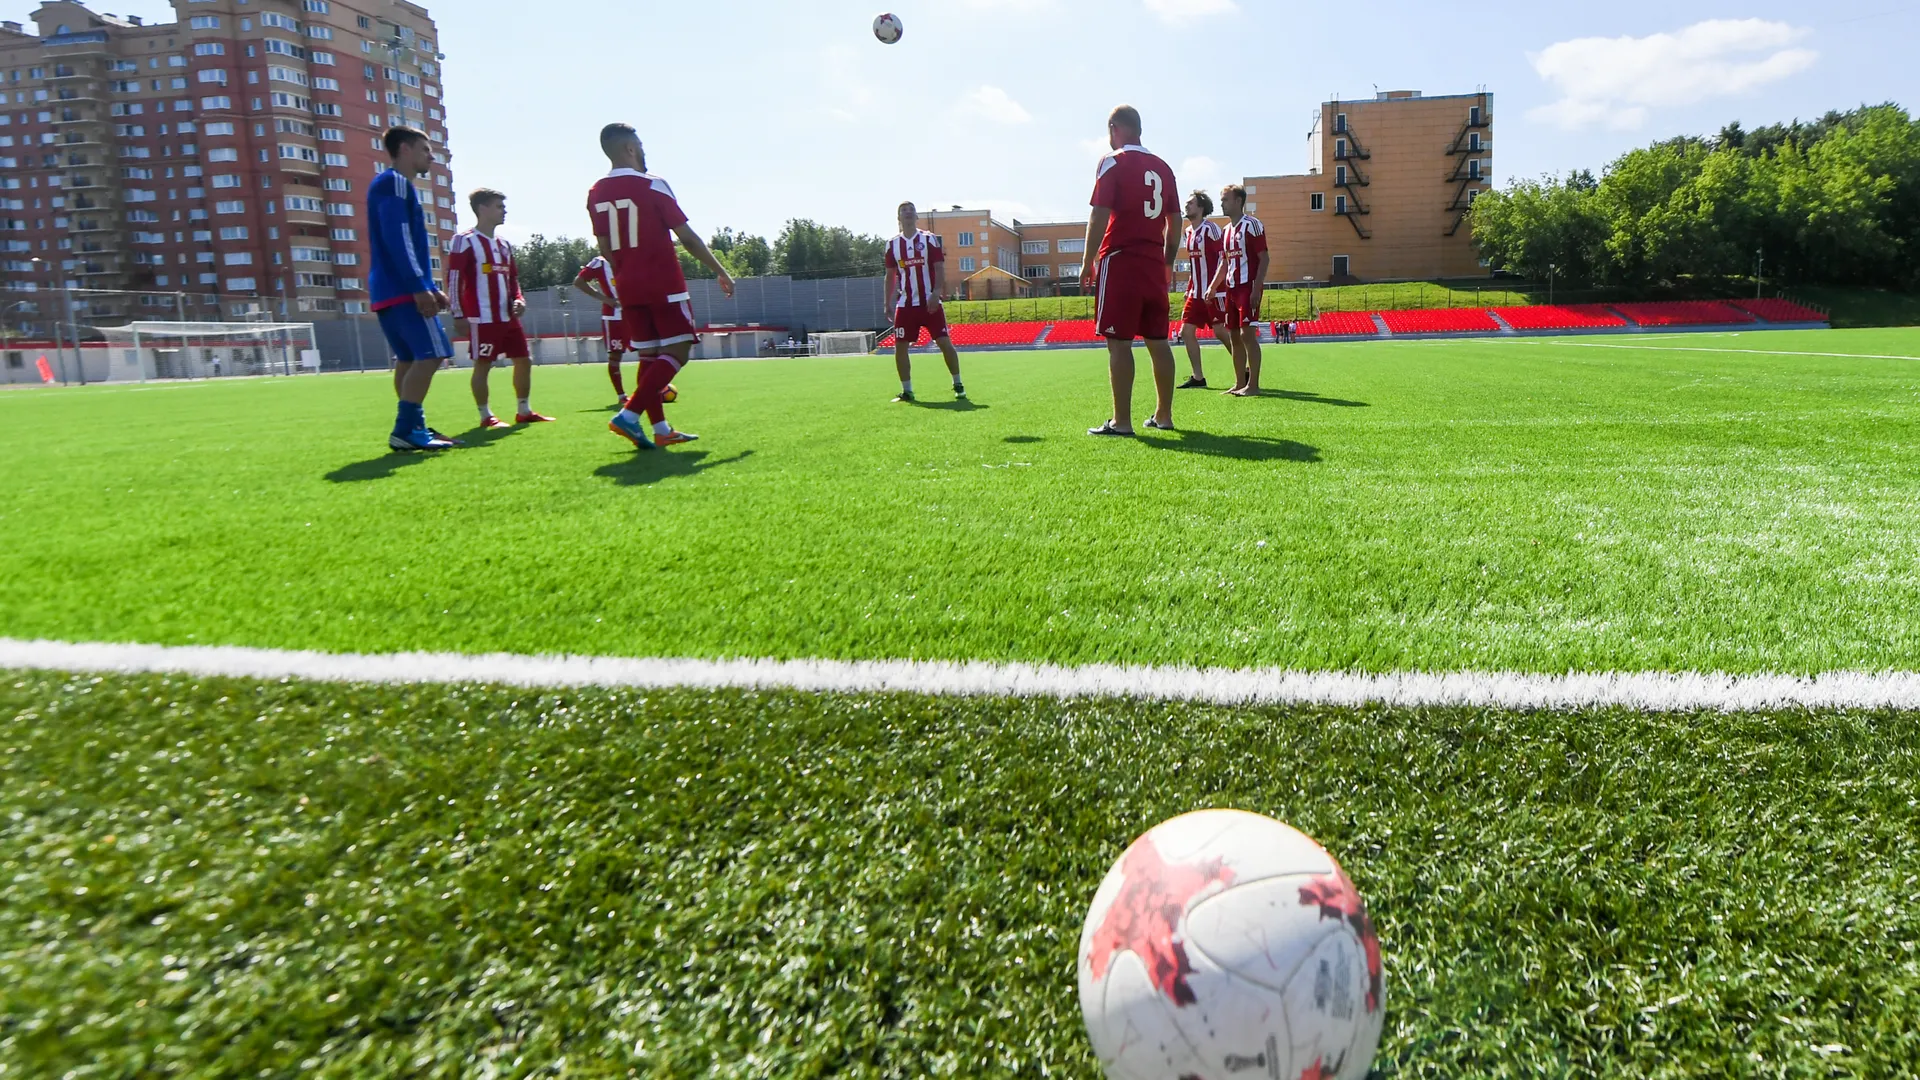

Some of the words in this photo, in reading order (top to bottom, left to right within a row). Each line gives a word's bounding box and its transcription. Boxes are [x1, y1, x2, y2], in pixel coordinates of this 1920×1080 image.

[1143, 170, 1163, 219] 3
[594, 198, 638, 251] 77
[895, 327, 905, 338] 19
[479, 343, 494, 356] 27
